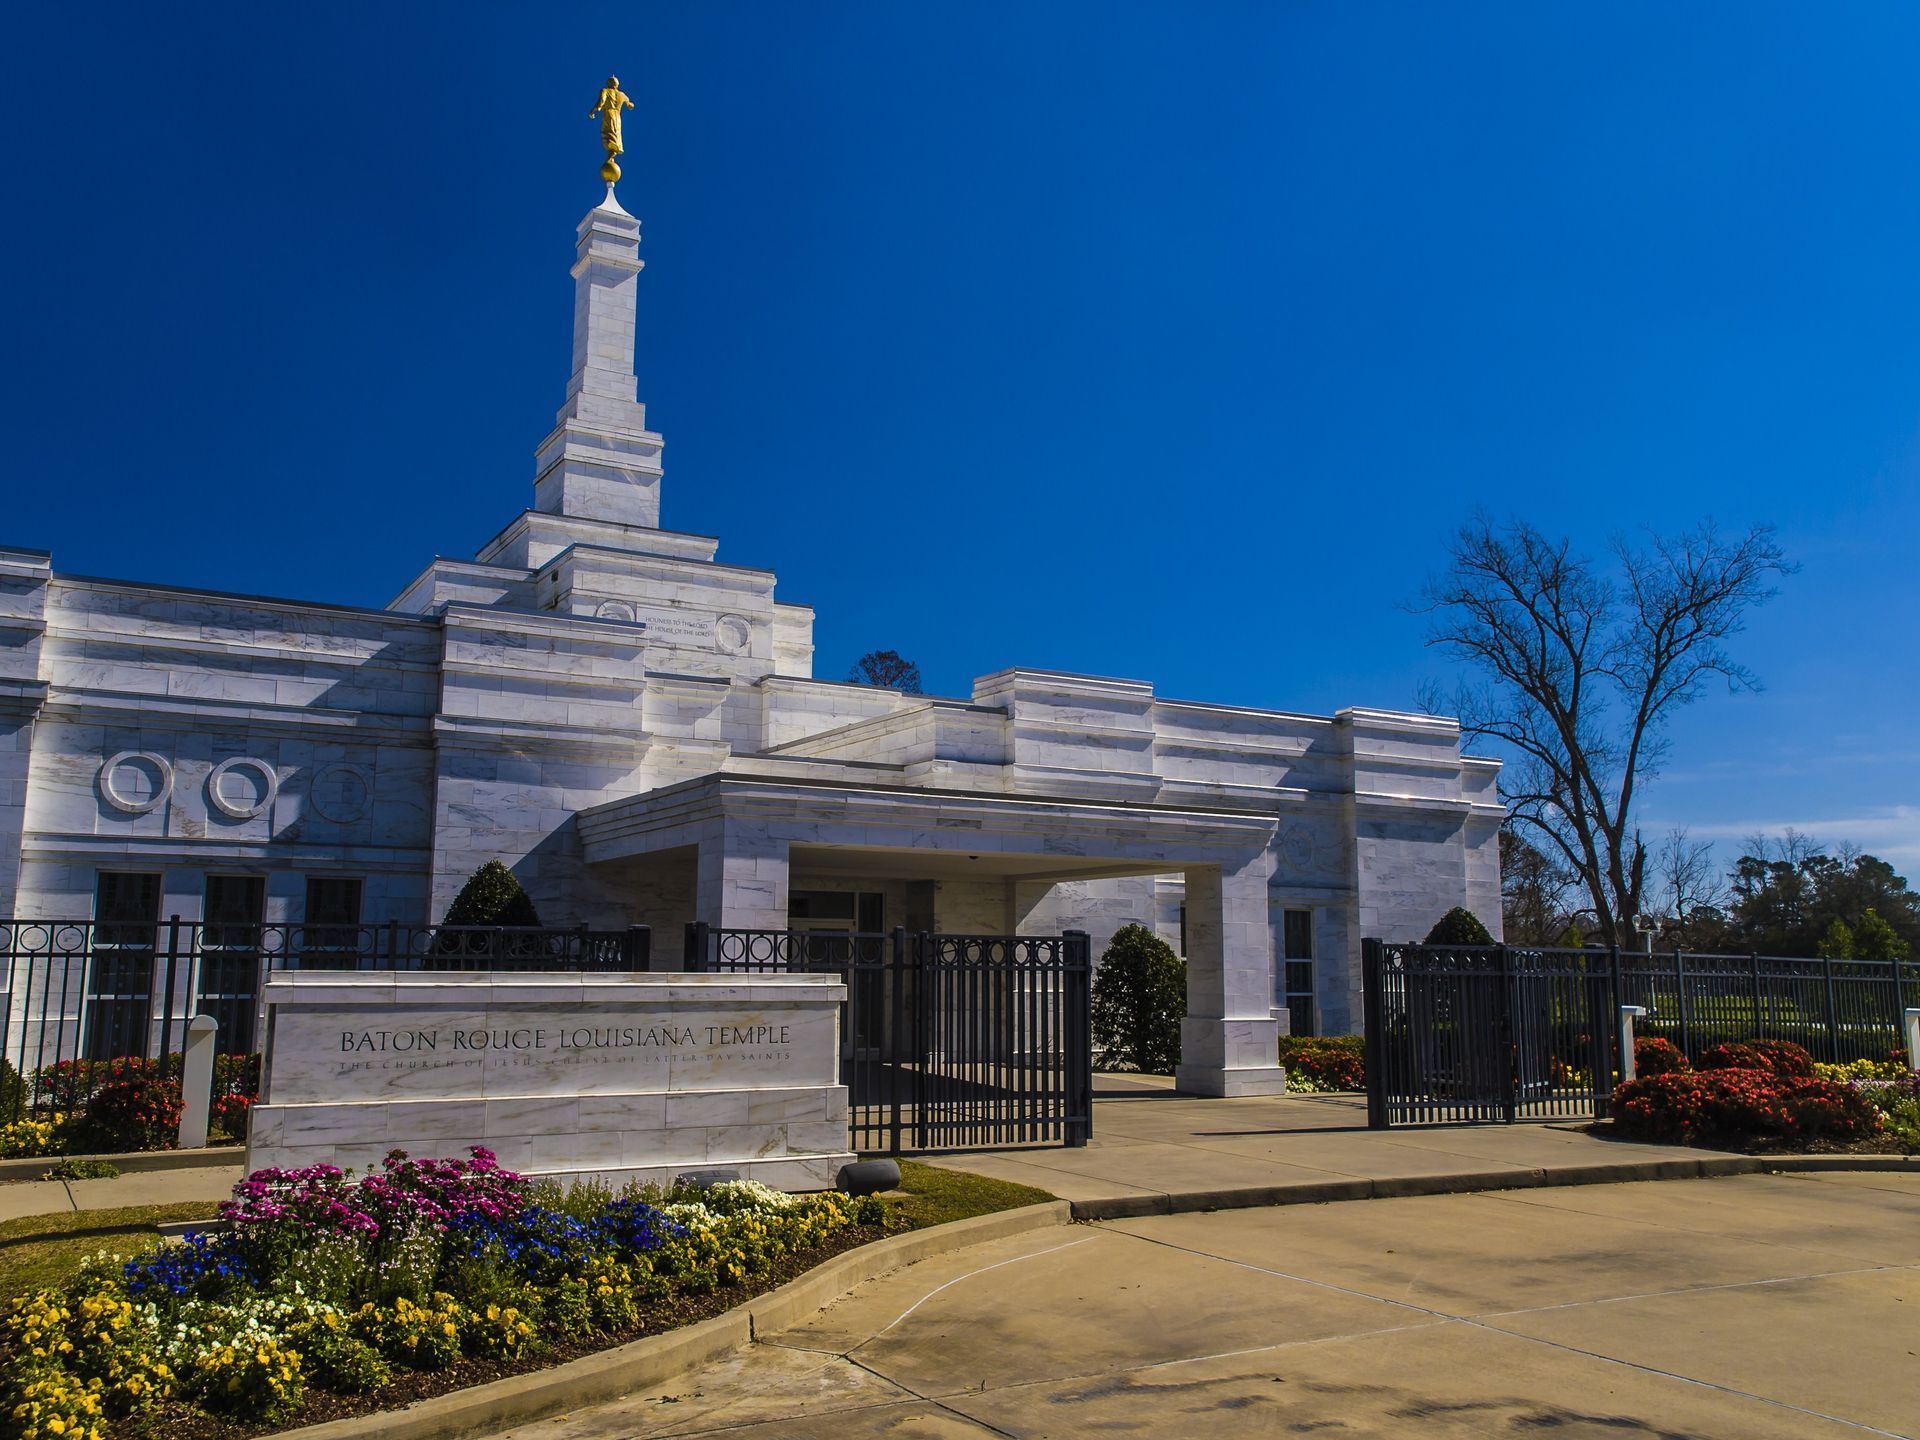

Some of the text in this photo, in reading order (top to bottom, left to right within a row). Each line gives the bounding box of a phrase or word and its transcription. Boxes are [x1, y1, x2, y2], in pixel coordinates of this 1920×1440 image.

[341, 1025, 790, 1052] BATON ROUGE LOUISIANA TEMPLE
[340, 1061, 372, 1070] THE
[382, 1060, 454, 1069] CHURCH
[464, 1058, 484, 1067] OF
[741, 1051, 790, 1061] SAINTS
